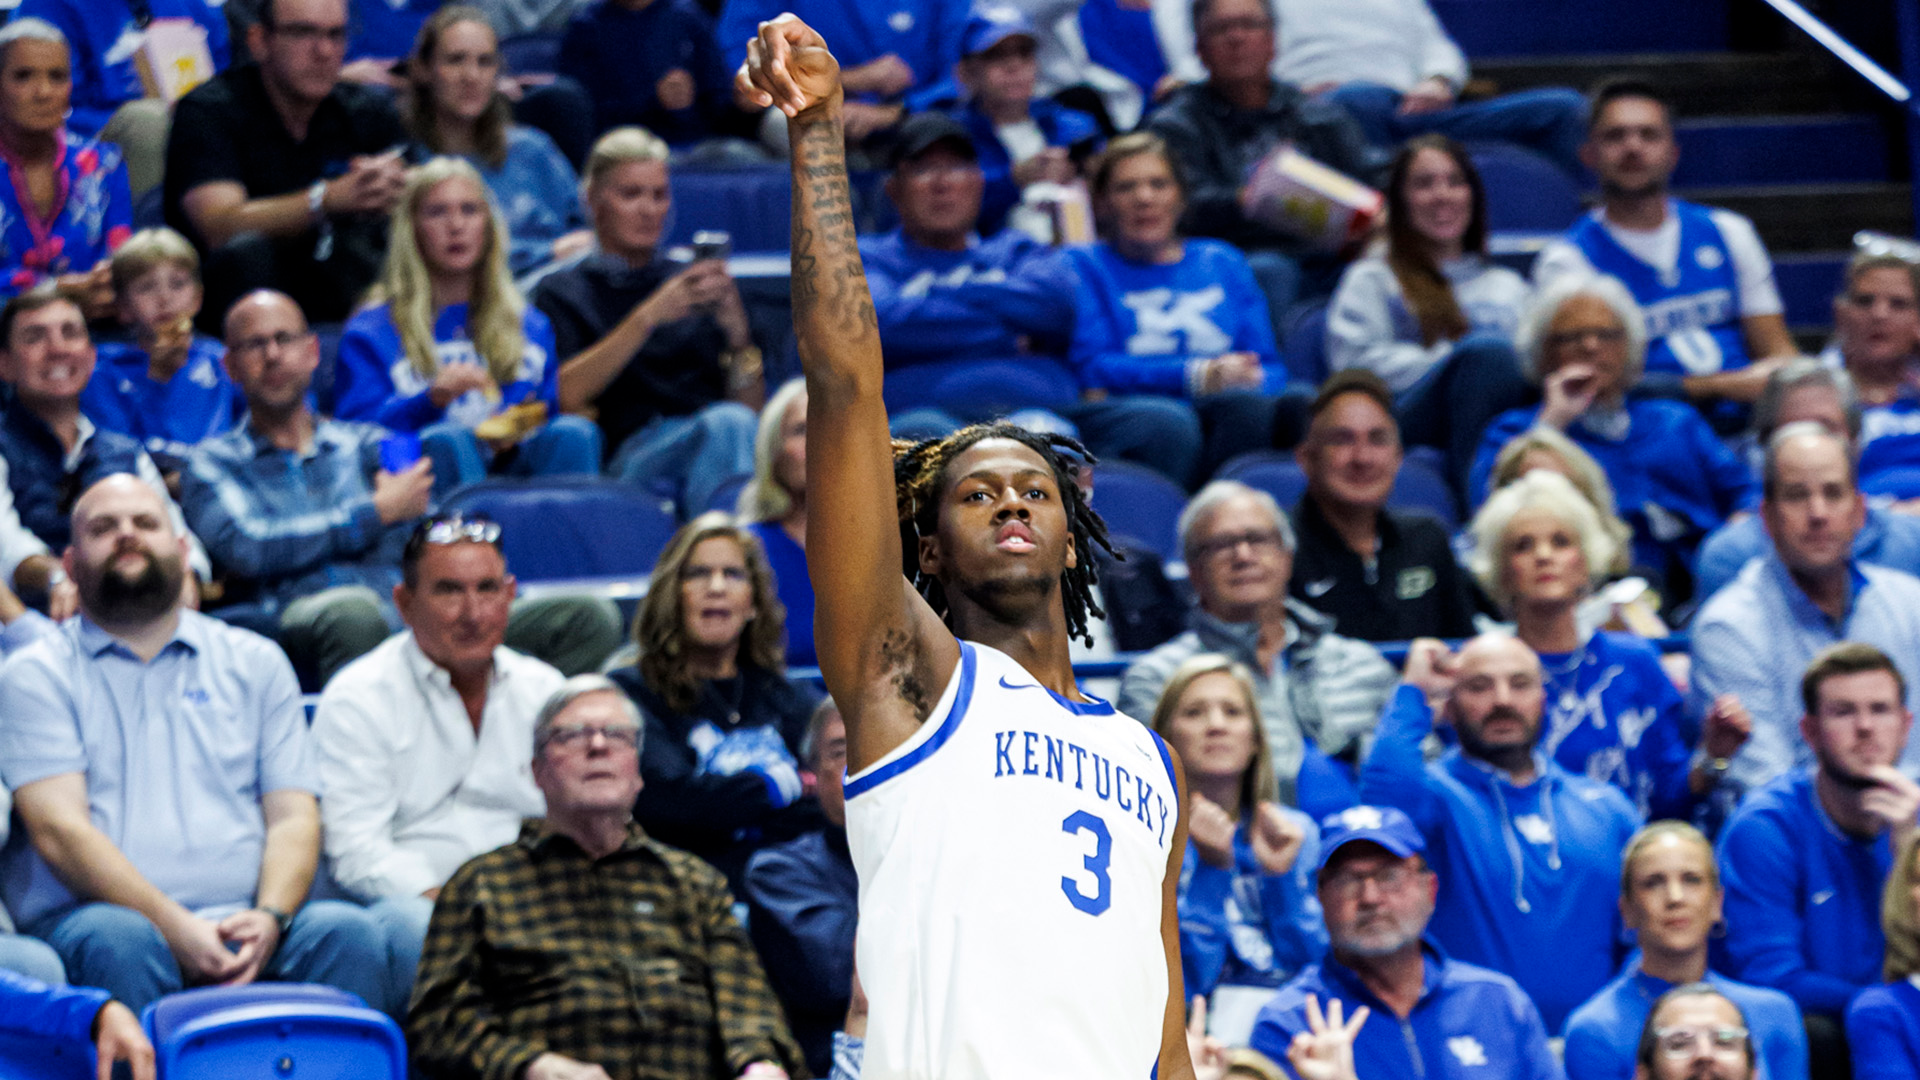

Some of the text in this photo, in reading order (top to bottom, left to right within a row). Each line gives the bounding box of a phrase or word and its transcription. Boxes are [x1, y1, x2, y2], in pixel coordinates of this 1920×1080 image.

[1123, 285, 1232, 355] K
[995, 731, 1168, 849] KENTUCKY
[1061, 809, 1112, 917] 3
